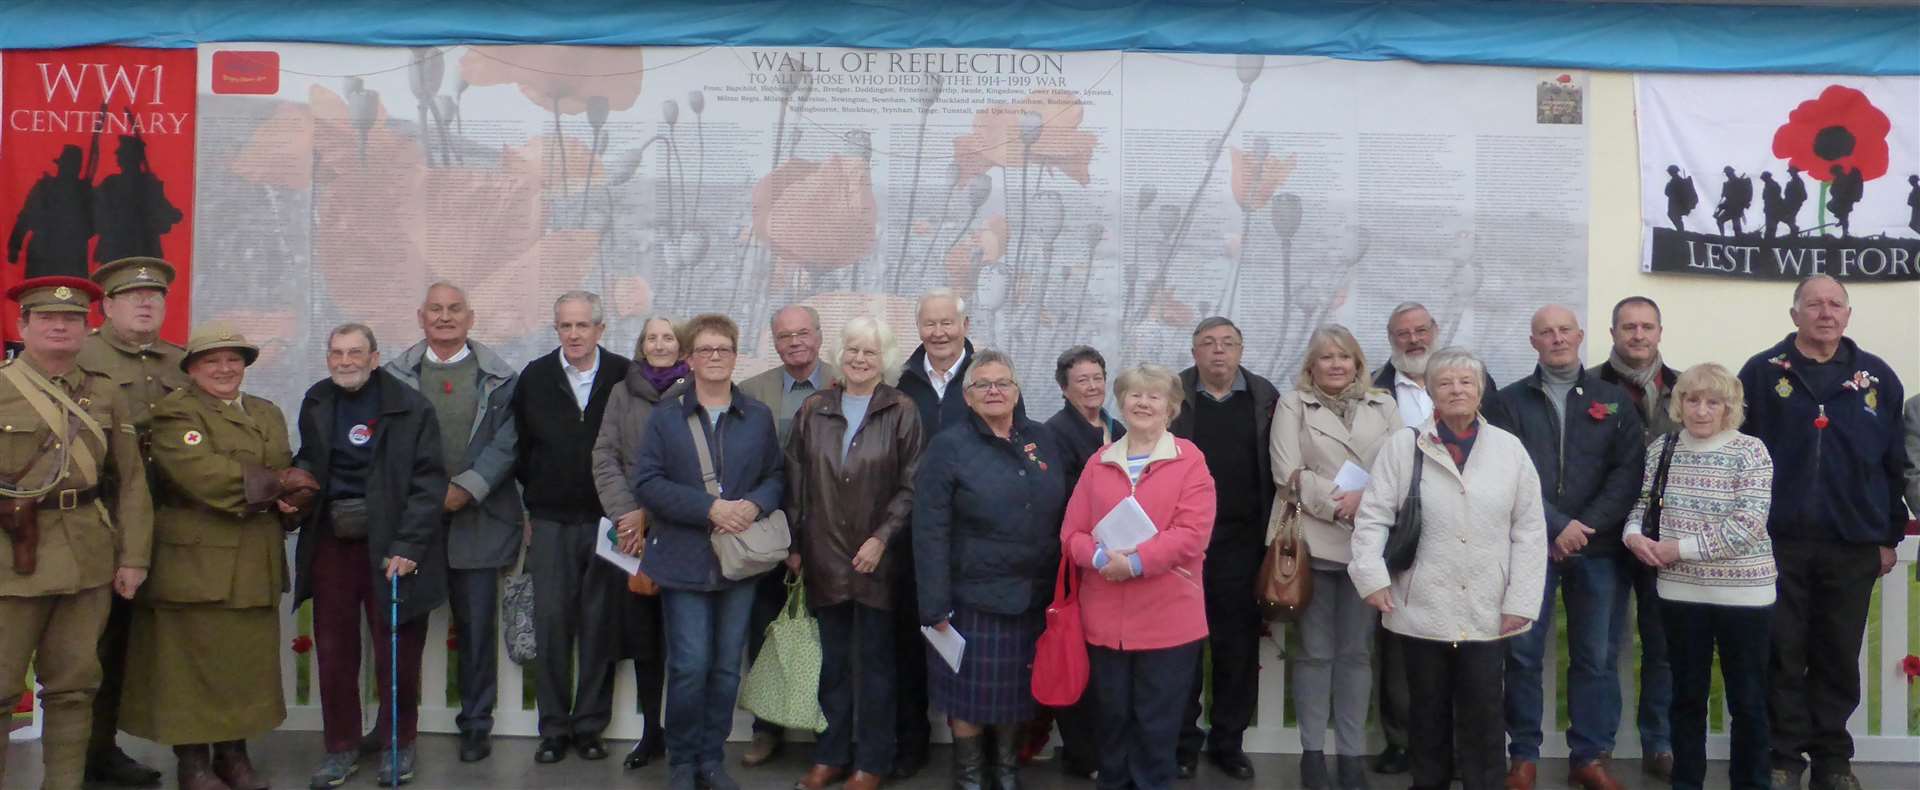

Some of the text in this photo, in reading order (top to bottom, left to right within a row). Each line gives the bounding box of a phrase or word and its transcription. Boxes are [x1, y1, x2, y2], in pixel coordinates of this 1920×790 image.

[752, 52, 1063, 74] WALL OF REFLECTION
[36, 63, 164, 105] WW1
[750, 73, 767, 84] TO
[773, 73, 798, 85] ALL
[802, 74, 844, 85] THOSE
[849, 74, 884, 85] WHO
[888, 74, 920, 86] DIED
[925, 74, 941, 86] IN
[943, 75, 973, 86] THE
[1036, 75, 1067, 87] WAR
[10, 110, 188, 135] CENTENARY
[1687, 240, 1760, 273] LEST
[1772, 248, 1827, 276] WE
